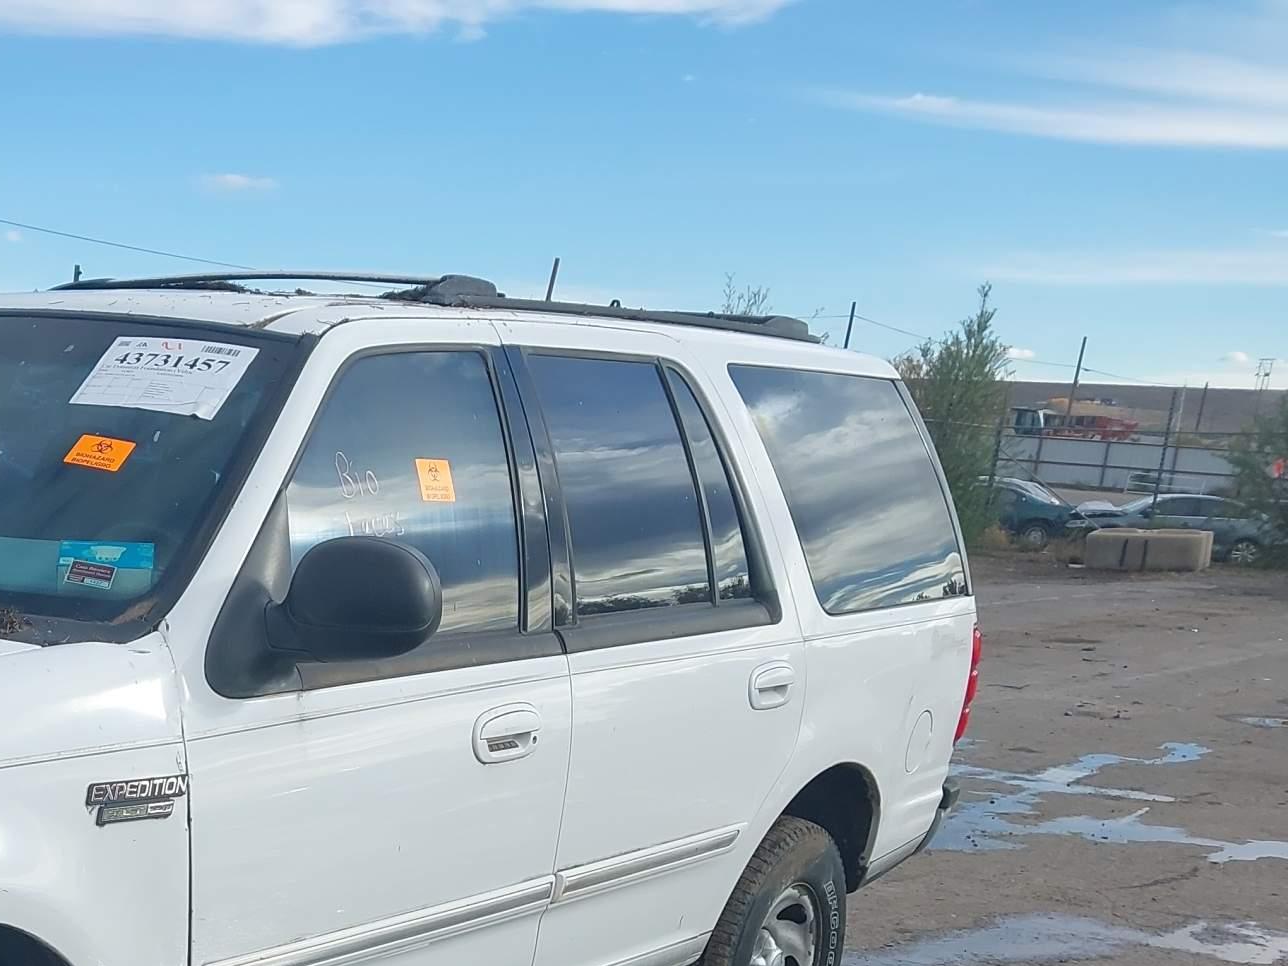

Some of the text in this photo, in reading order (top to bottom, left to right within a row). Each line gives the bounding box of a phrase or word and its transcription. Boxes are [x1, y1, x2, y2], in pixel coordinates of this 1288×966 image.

[114, 351, 231, 374] 43731457
[76, 452, 116, 464] BIOHAZARD
[91, 776, 188, 802] EXPEDITION
